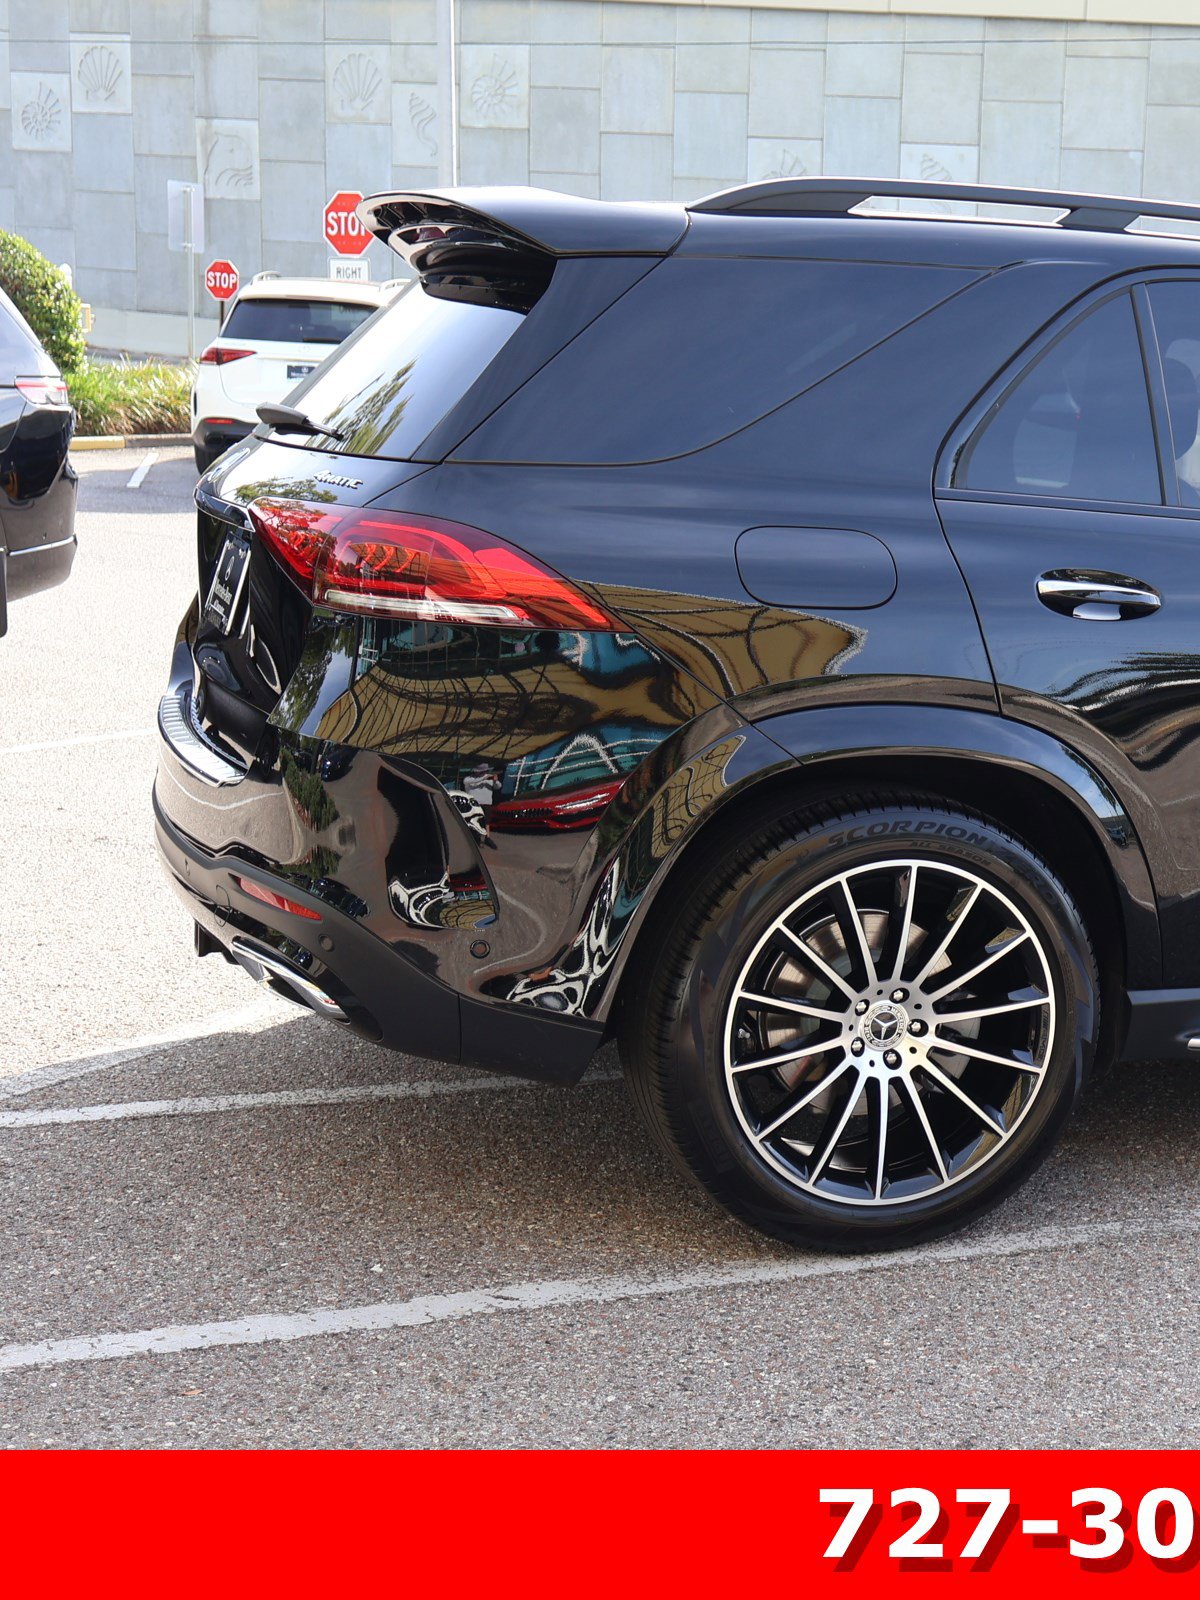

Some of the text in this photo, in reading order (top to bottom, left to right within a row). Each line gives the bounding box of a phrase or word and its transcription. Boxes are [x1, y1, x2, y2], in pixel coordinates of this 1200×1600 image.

[207, 271, 236, 289] STOP
[336, 266, 362, 279] RIGHT
[828, 820, 988, 849] SCORPION
[909, 840, 992, 868] ALL SEASON
